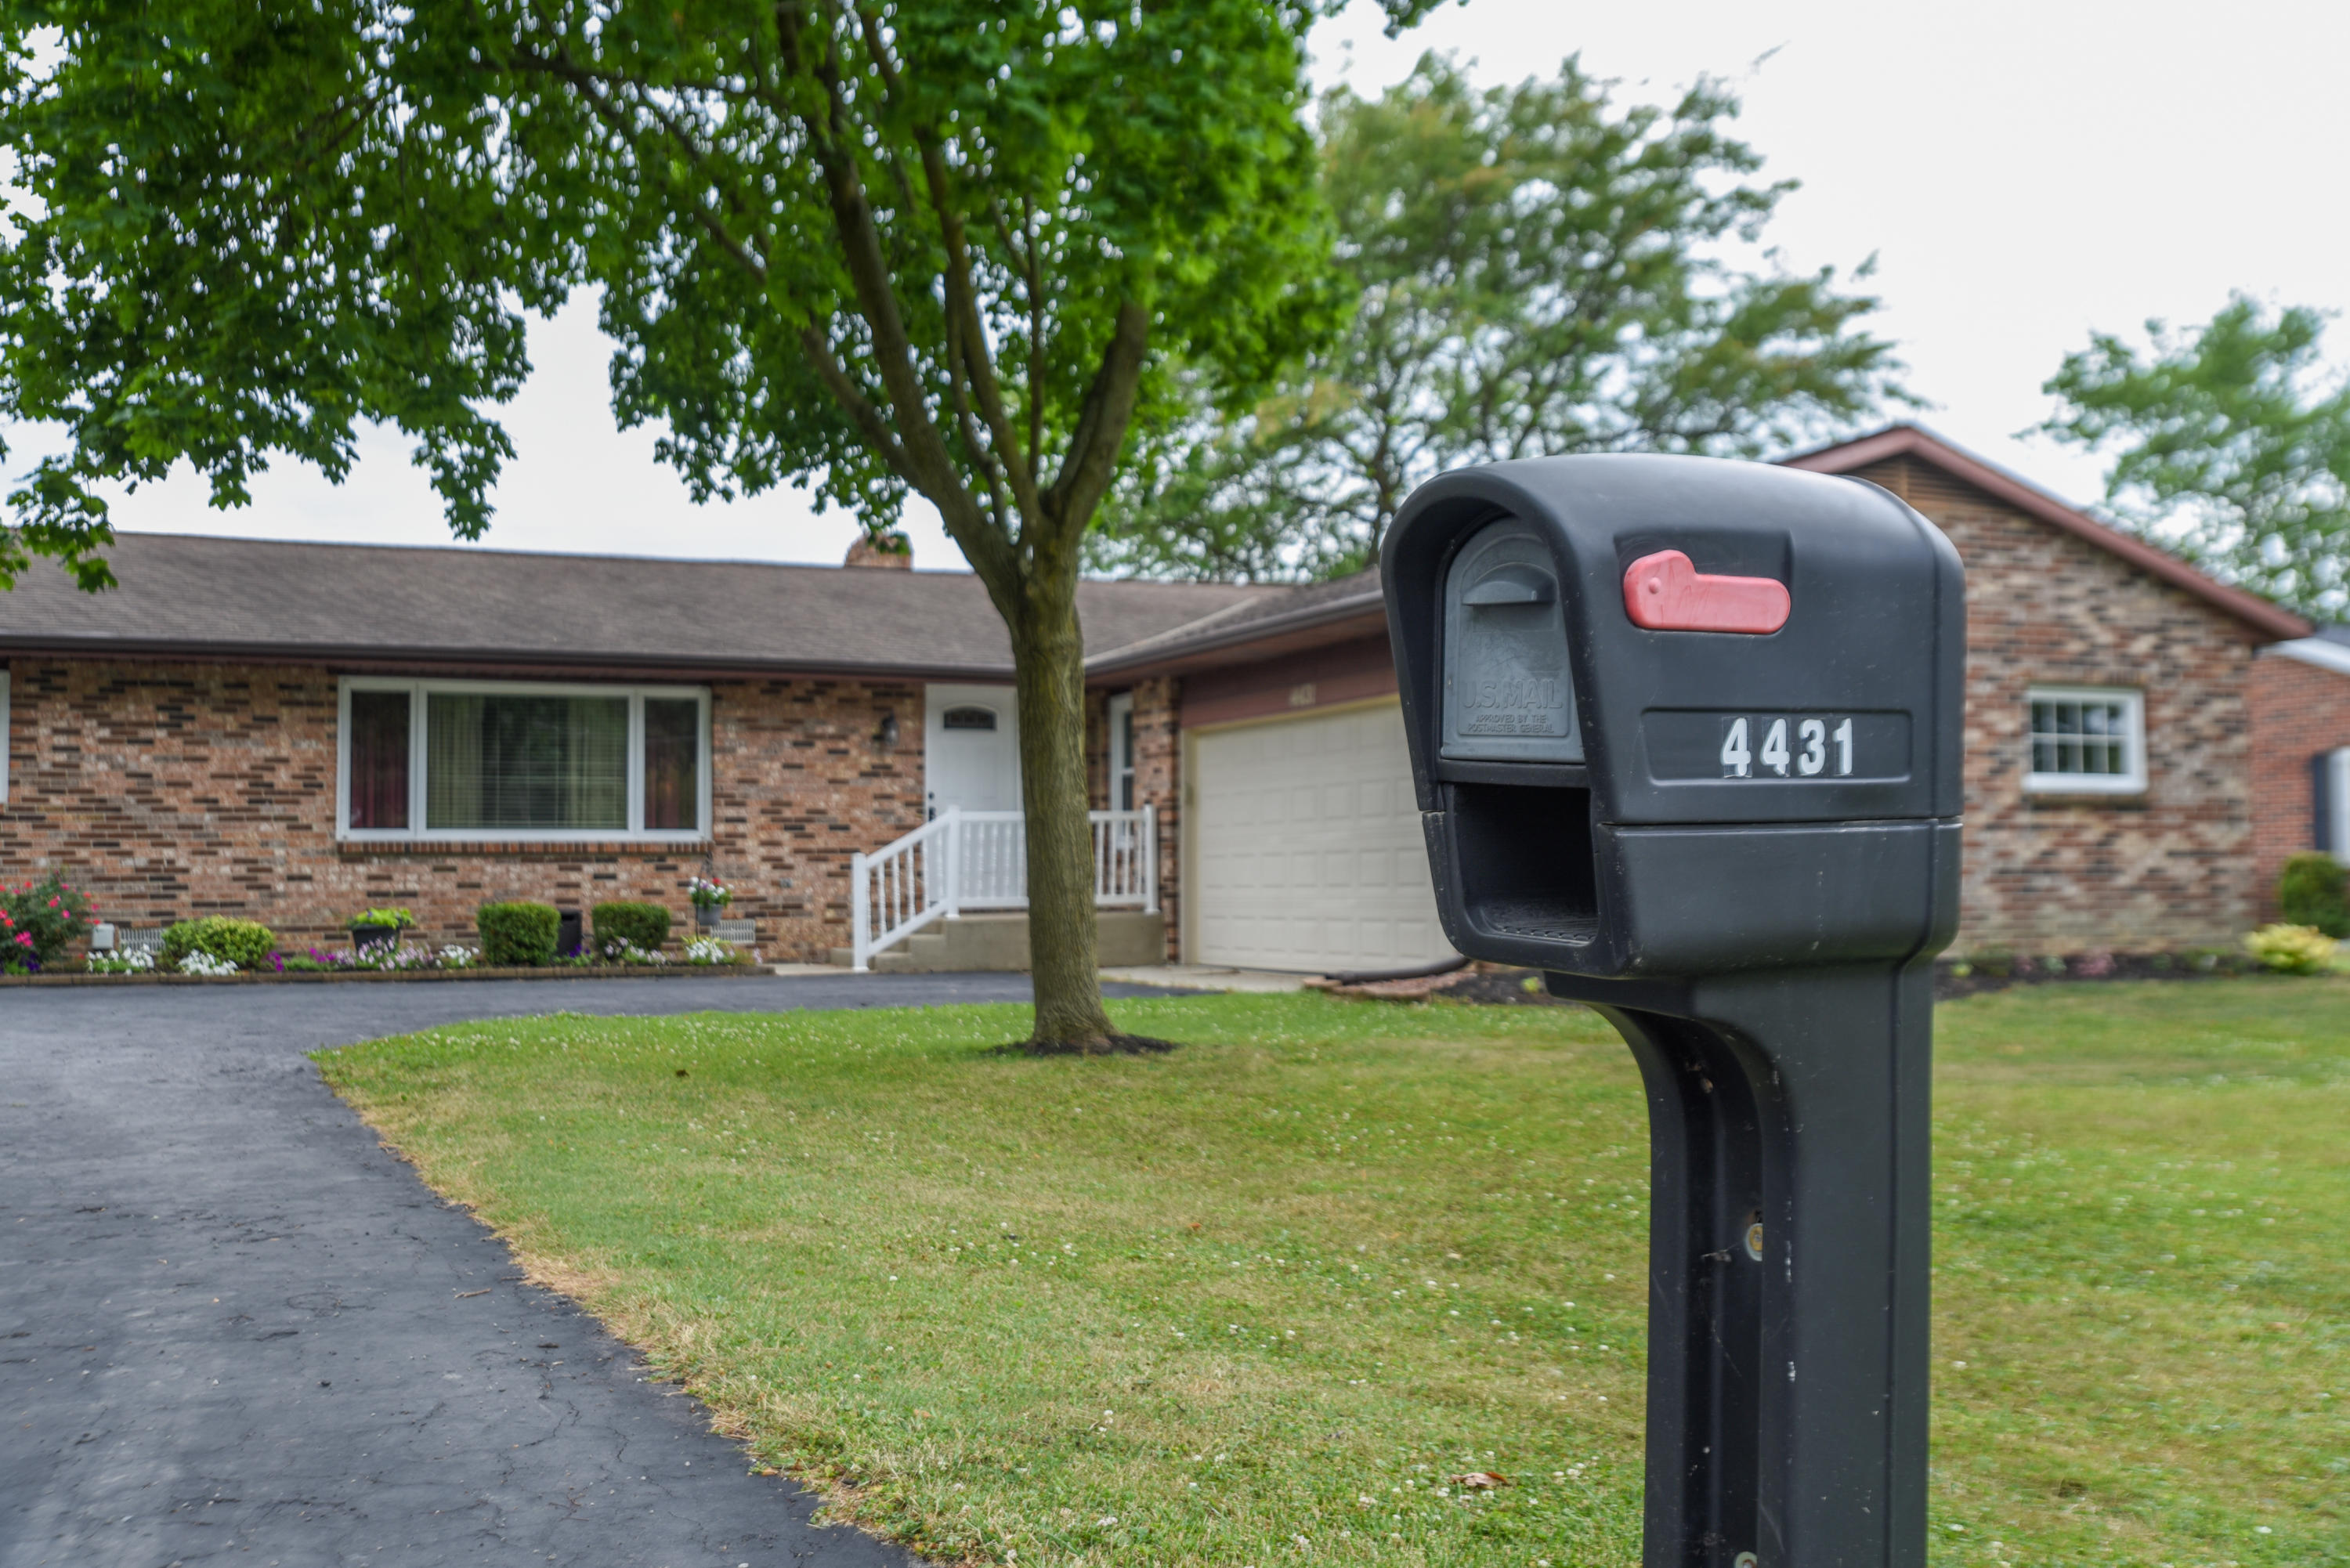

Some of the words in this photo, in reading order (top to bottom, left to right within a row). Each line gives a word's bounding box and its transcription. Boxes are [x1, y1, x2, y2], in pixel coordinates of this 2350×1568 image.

[1476, 714, 1516, 724] APPROVED
[1517, 714, 1528, 724] BY
[1532, 714, 1546, 724] THE
[1468, 723, 1517, 733] POSTMASTER
[1520, 724, 1555, 734] GENERAL
[1720, 717, 1853, 775] 4431
